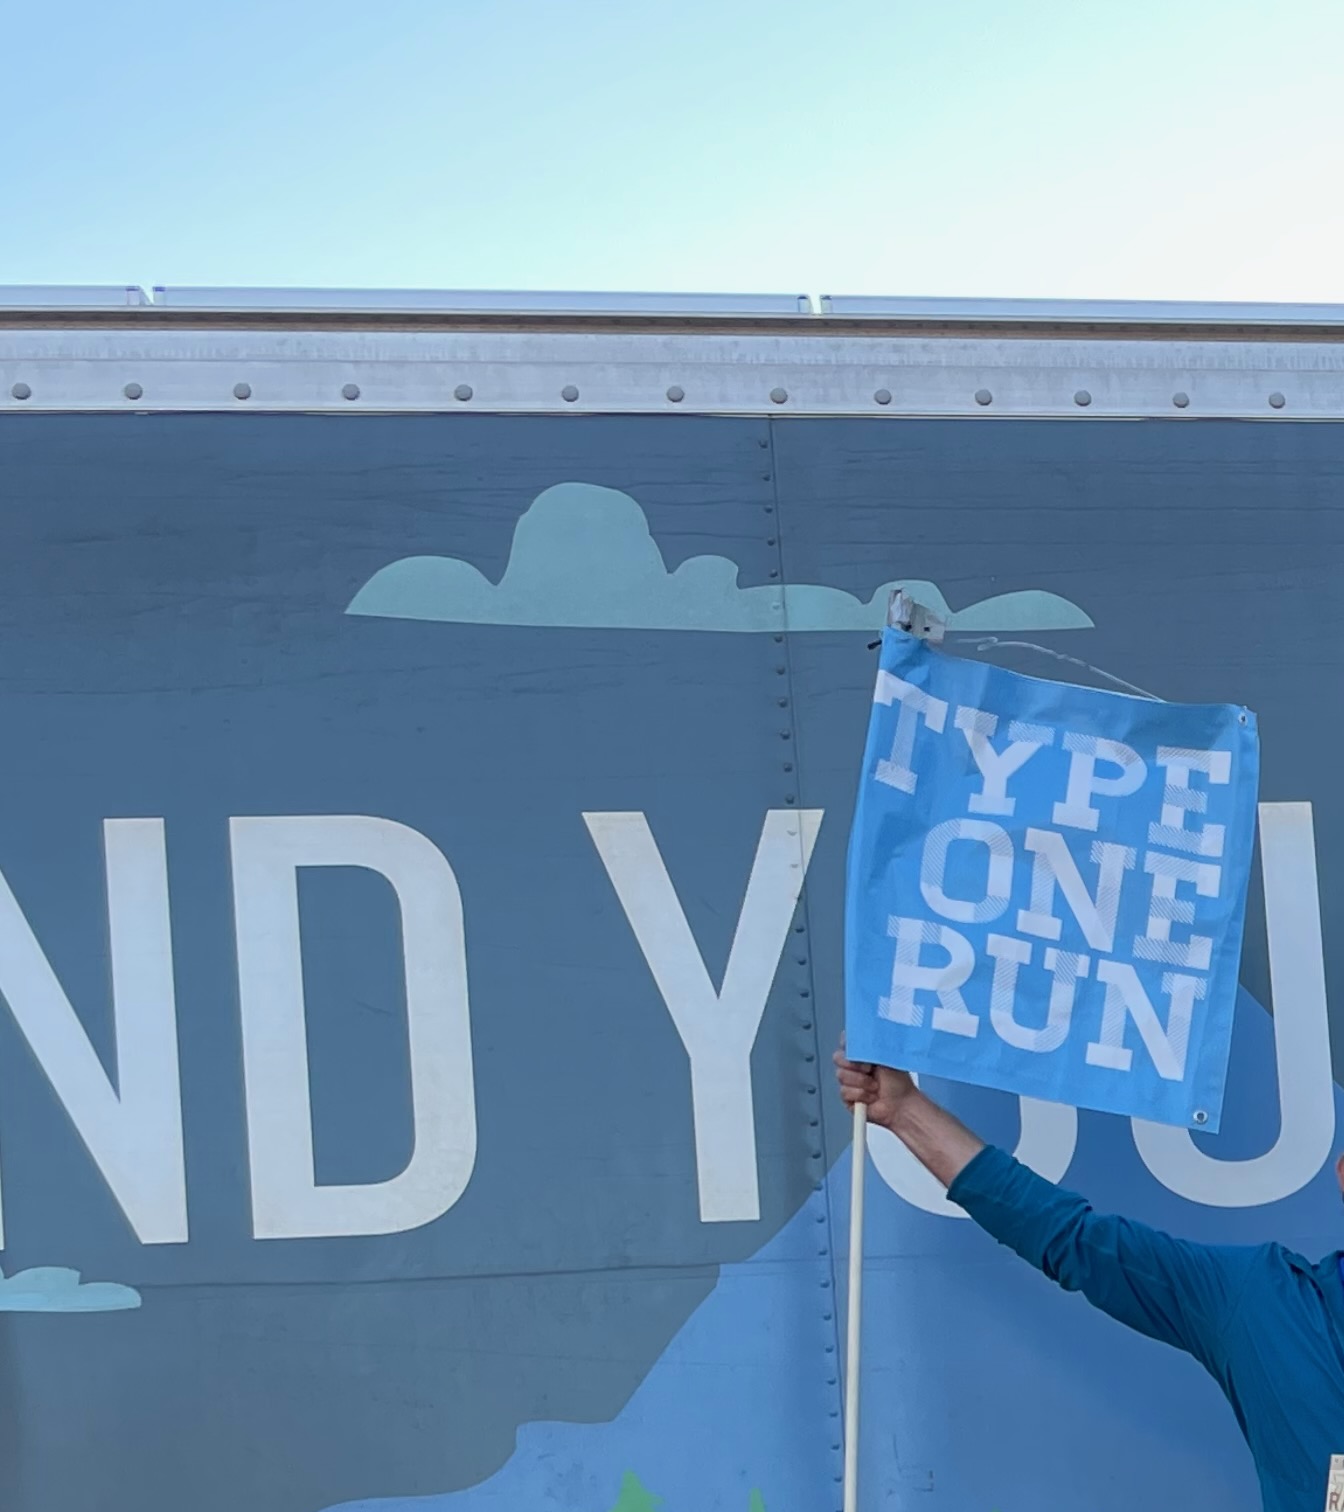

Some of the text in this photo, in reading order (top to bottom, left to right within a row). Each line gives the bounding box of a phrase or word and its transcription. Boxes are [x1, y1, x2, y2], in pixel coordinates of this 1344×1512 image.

[874, 669, 1231, 858] TYPE
[919, 818, 1222, 969] ONE
[877, 915, 1207, 1082] RUN
